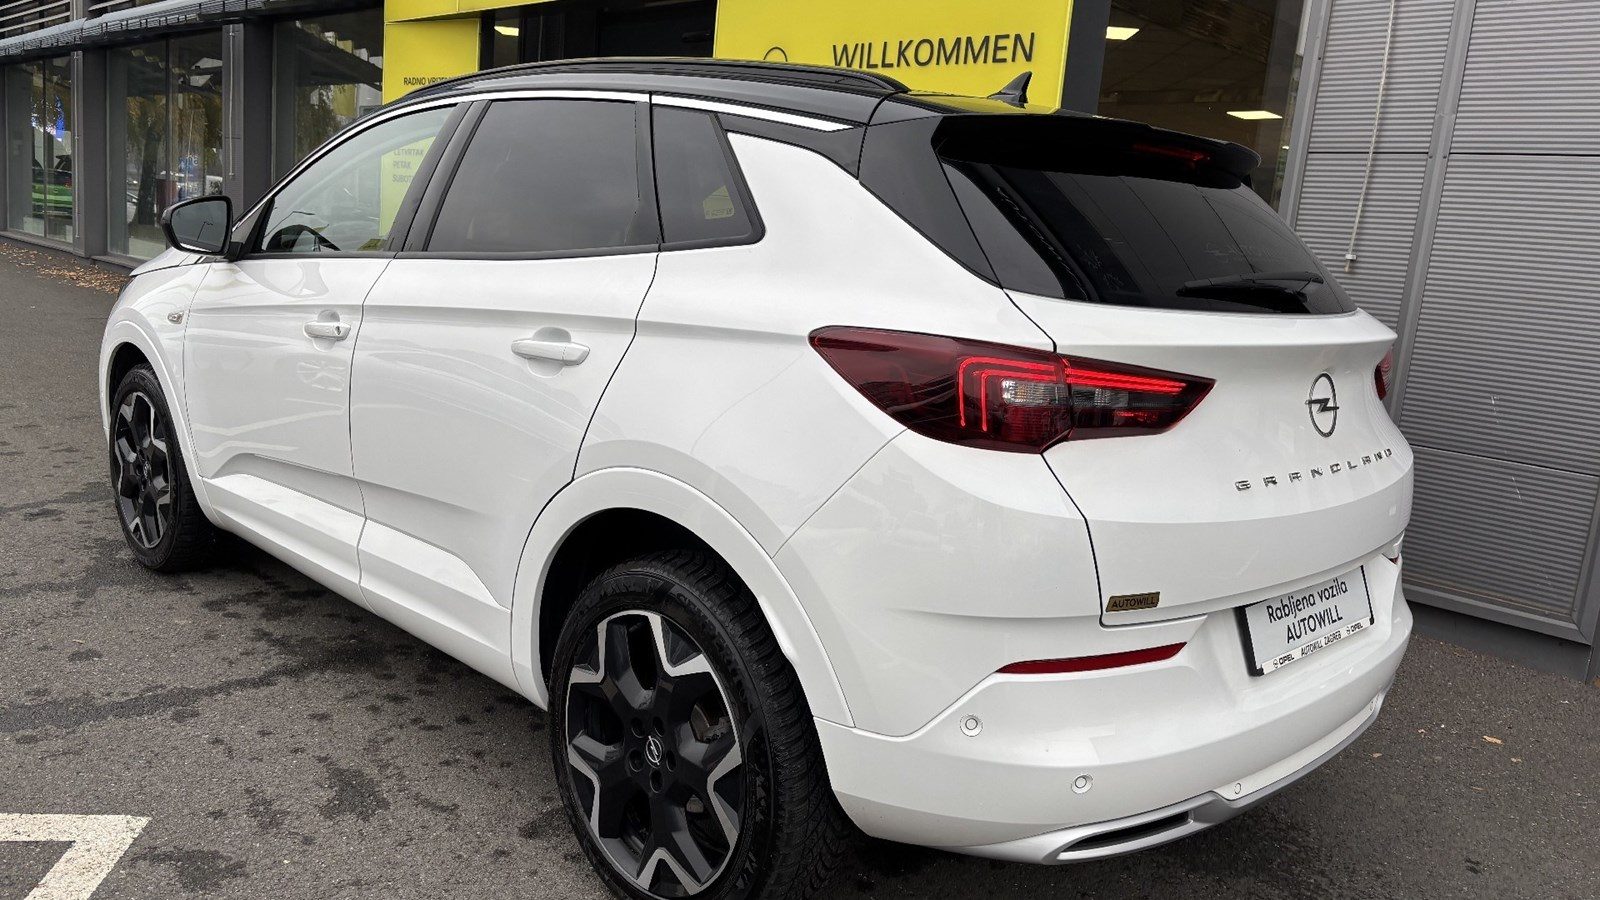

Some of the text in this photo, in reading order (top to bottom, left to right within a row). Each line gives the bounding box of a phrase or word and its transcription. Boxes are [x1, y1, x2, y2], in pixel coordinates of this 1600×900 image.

[832, 32, 1036, 69] WILLKOMMEN
[403, 77, 426, 86] RADNO
[1234, 448, 1393, 492] GRANDLAND
[1112, 597, 1155, 608] AUTOWILL
[1266, 577, 1348, 624] Rabljena vozila
[1286, 604, 1343, 643] AUTOWILL
[1278, 622, 1364, 665] OPEL AUTOWILL ZAGREB OPEL
